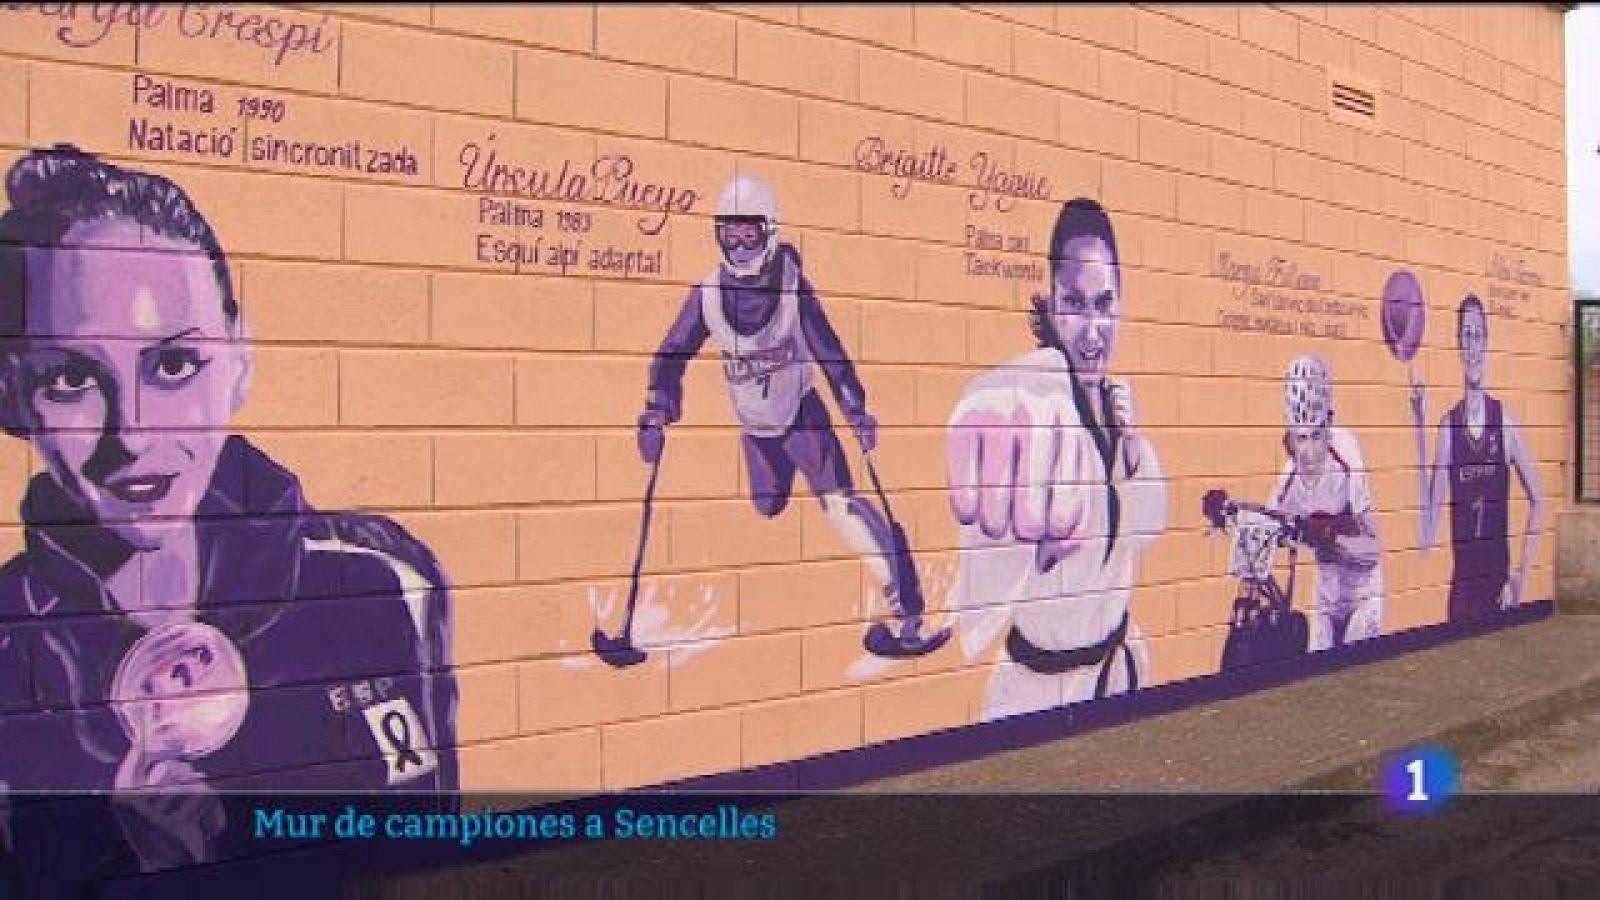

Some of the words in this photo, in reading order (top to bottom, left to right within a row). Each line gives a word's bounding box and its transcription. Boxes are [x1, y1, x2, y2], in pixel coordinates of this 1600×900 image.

[133, 75, 214, 114] Palma
[129, 118, 237, 158] Natació
[479, 198, 544, 229] Palma
